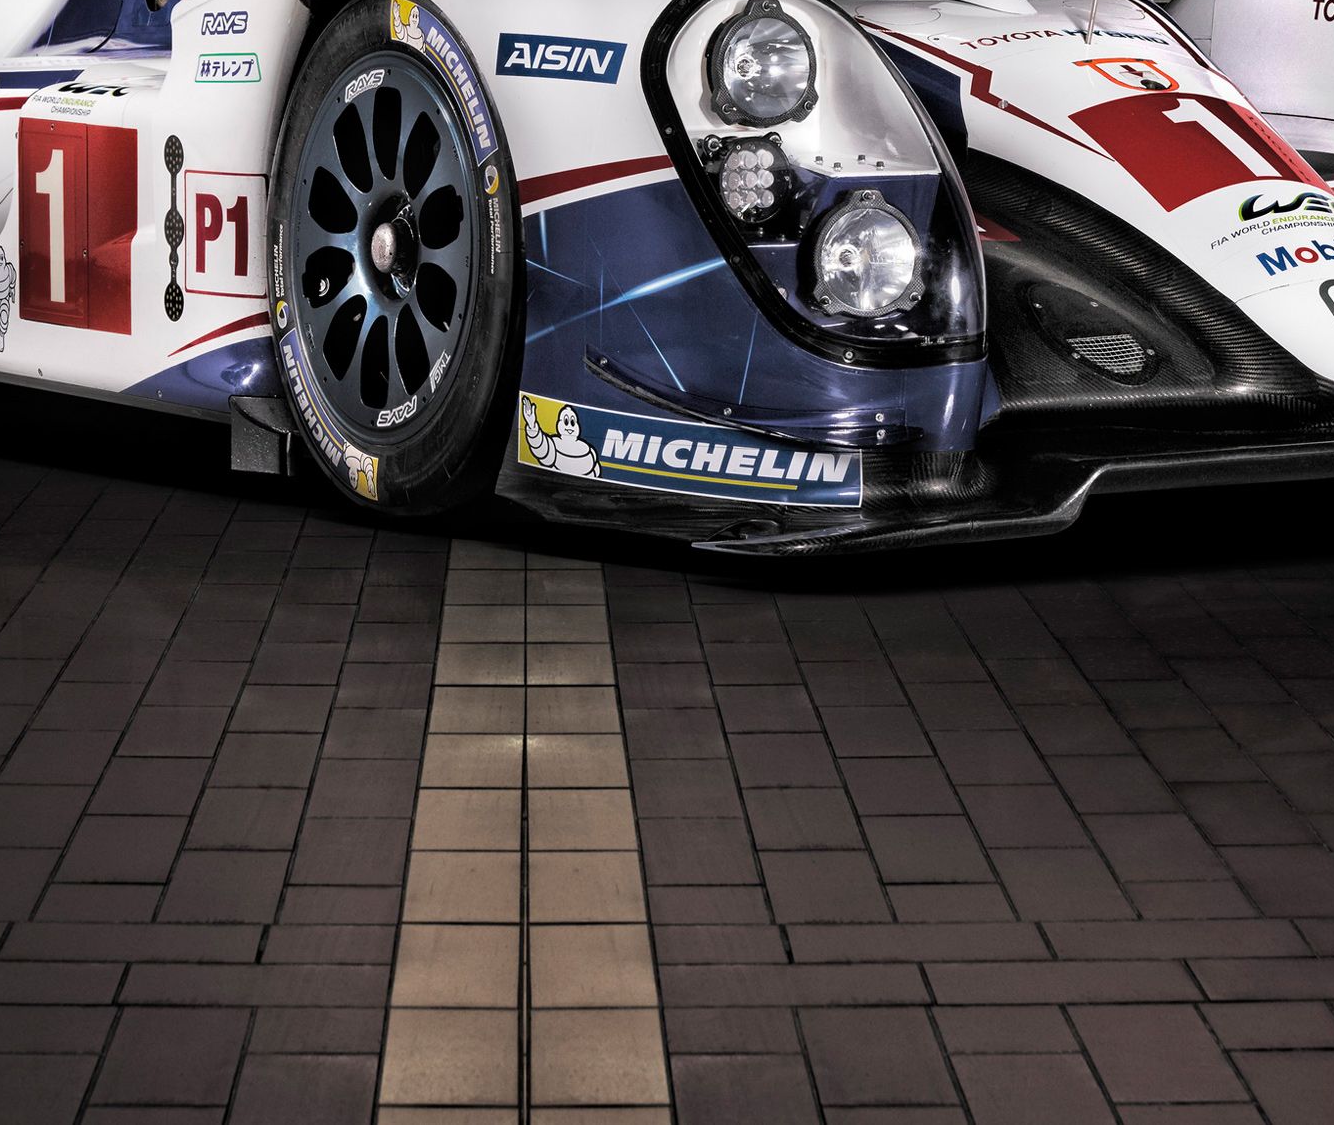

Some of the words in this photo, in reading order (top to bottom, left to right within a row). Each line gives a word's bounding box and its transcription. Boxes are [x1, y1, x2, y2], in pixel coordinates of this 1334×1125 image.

[201, 11, 248, 35] RAYS
[960, 30, 1063, 50] TOYOTA
[200, 59, 255, 77] 林テレンプ
[504, 42, 614, 75] AISIN
[345, 69, 385, 103] RAYS
[426, 27, 491, 148] MICHELIN
[1161, 98, 1282, 178] 1
[35, 149, 66, 303] 1
[195, 192, 249, 277] P1
[492, 197, 501, 254] MICHELIN
[1210, 236, 1229, 250] FIA
[1230, 220, 1271, 240] WORLD
[283, 344, 342, 467] MICHELIN
[377, 395, 417, 427] RAYS
[601, 429, 853, 483] MICHELIN
